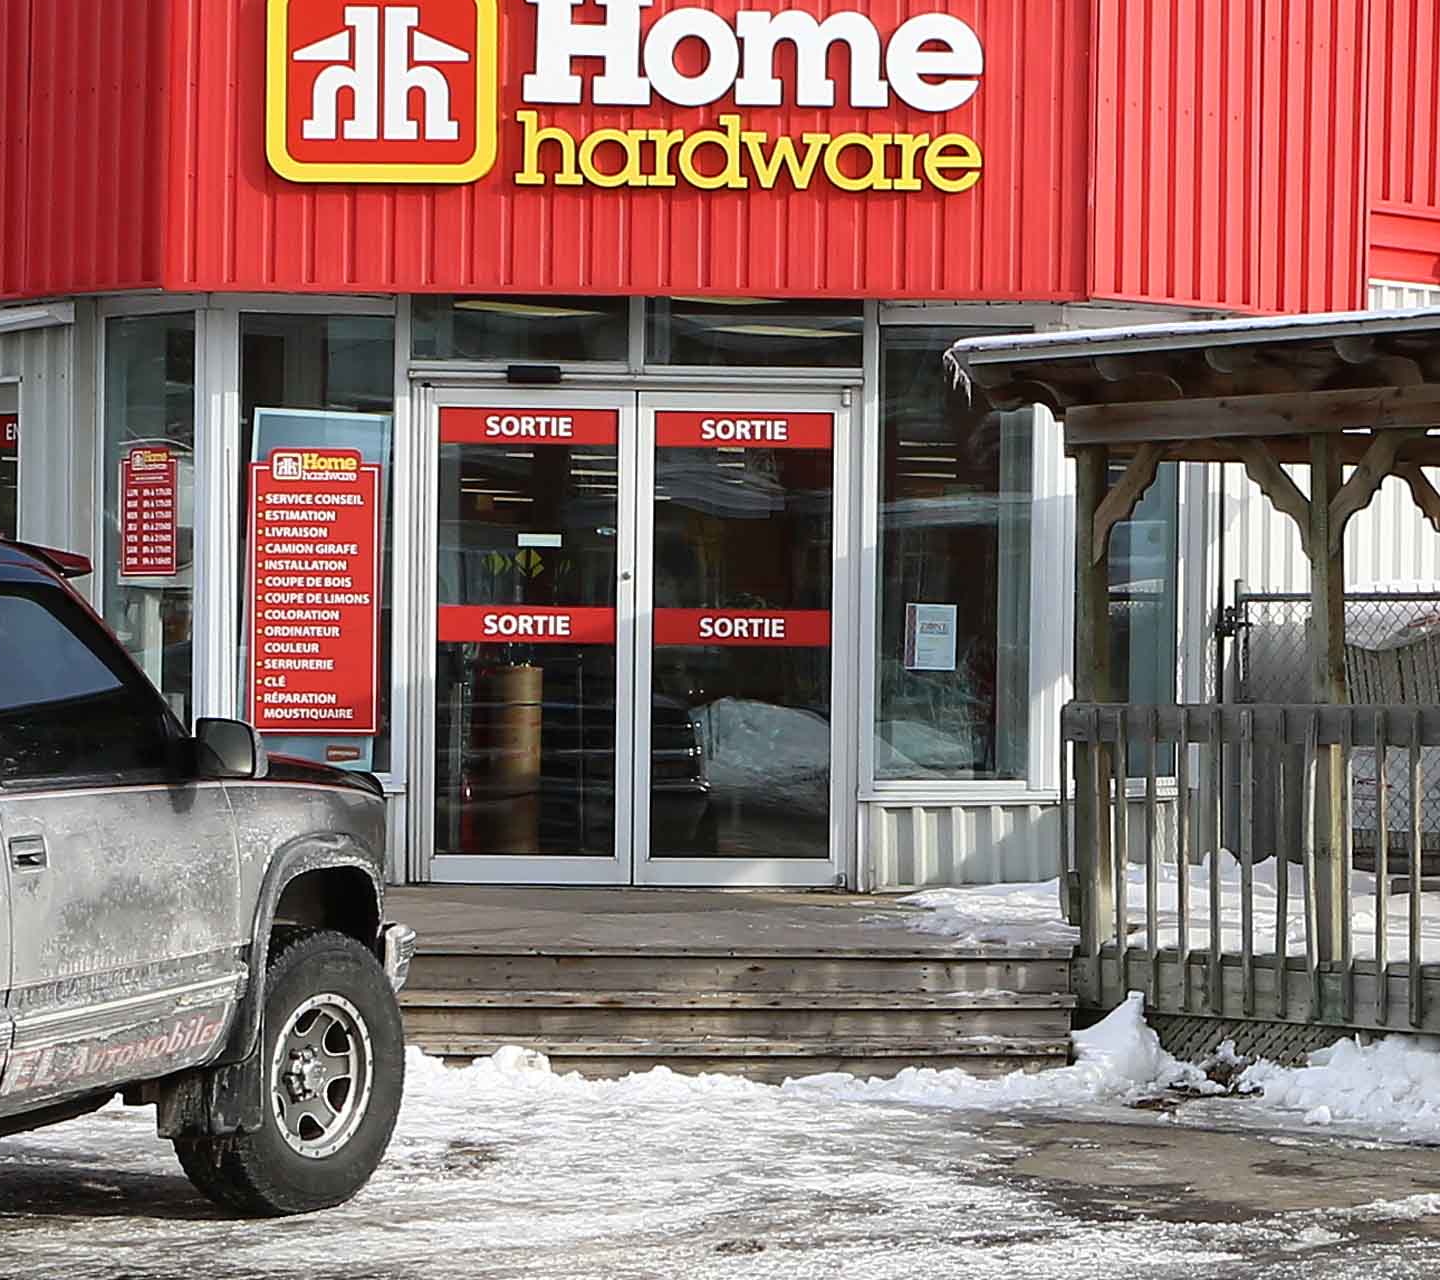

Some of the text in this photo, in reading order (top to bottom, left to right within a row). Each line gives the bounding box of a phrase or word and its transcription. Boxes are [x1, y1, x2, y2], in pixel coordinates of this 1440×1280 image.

[514, 110, 983, 193] hardware
[487, 416, 571, 436] SORTIE
[703, 420, 786, 439] SORTIE
[302, 453, 357, 470] Home
[265, 494, 364, 505] SERVICE CONSEIL
[265, 510, 336, 521] ESTIMATION
[265, 527, 328, 537] LIVRAISON
[265, 543, 358, 554] CAMION GIRAFE
[264, 560, 347, 570] INSTALLATION
[264, 576, 352, 587] COUPE DE BOIS
[264, 593, 370, 604] COUPE DE LIMONS
[264, 610, 339, 620] COLORATION
[485, 615, 569, 634] SORTIE
[700, 618, 784, 637] SORTIE
[264, 626, 340, 637] ORDINATEUR
[264, 643, 320, 653] COULEUR
[264, 659, 334, 670] SERRURERIE
[264, 675, 287, 687] CLÉ
[264, 692, 336, 704] RÉPARATION
[263, 708, 353, 719] MOUSTIQUAIRE
